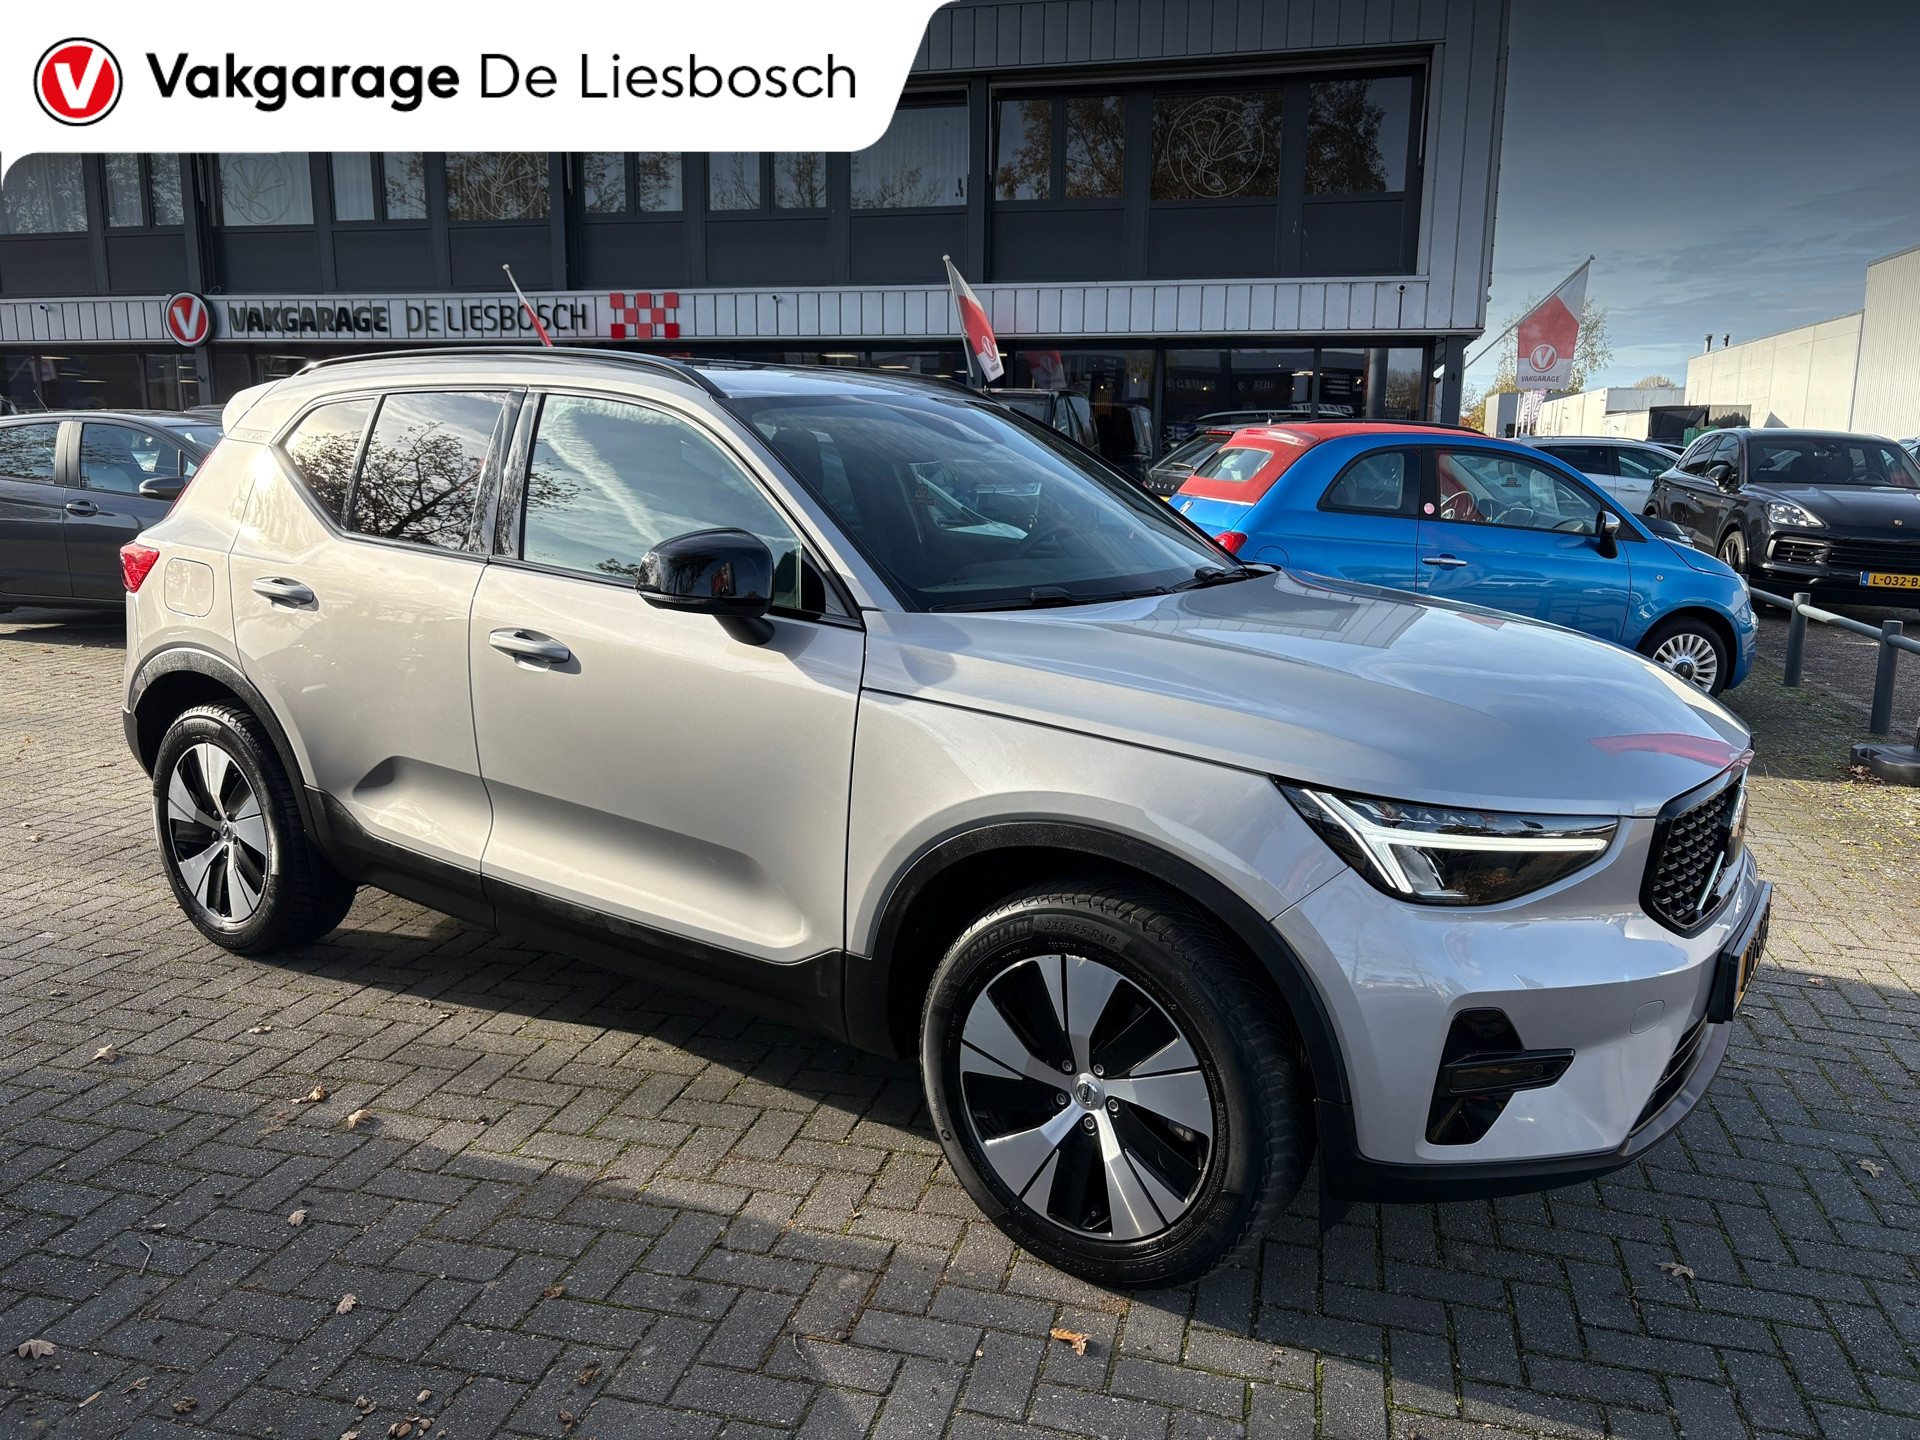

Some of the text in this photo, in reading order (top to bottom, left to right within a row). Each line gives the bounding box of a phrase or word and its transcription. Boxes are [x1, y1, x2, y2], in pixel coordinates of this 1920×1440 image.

[228, 303, 587, 332] VAKGARAGE DE LIESBOSCH
[1520, 375, 1560, 383] VAKGARAGE
[1872, 574, 1920, 588] L-032-B
[1104, 933, 1117, 945] 18
